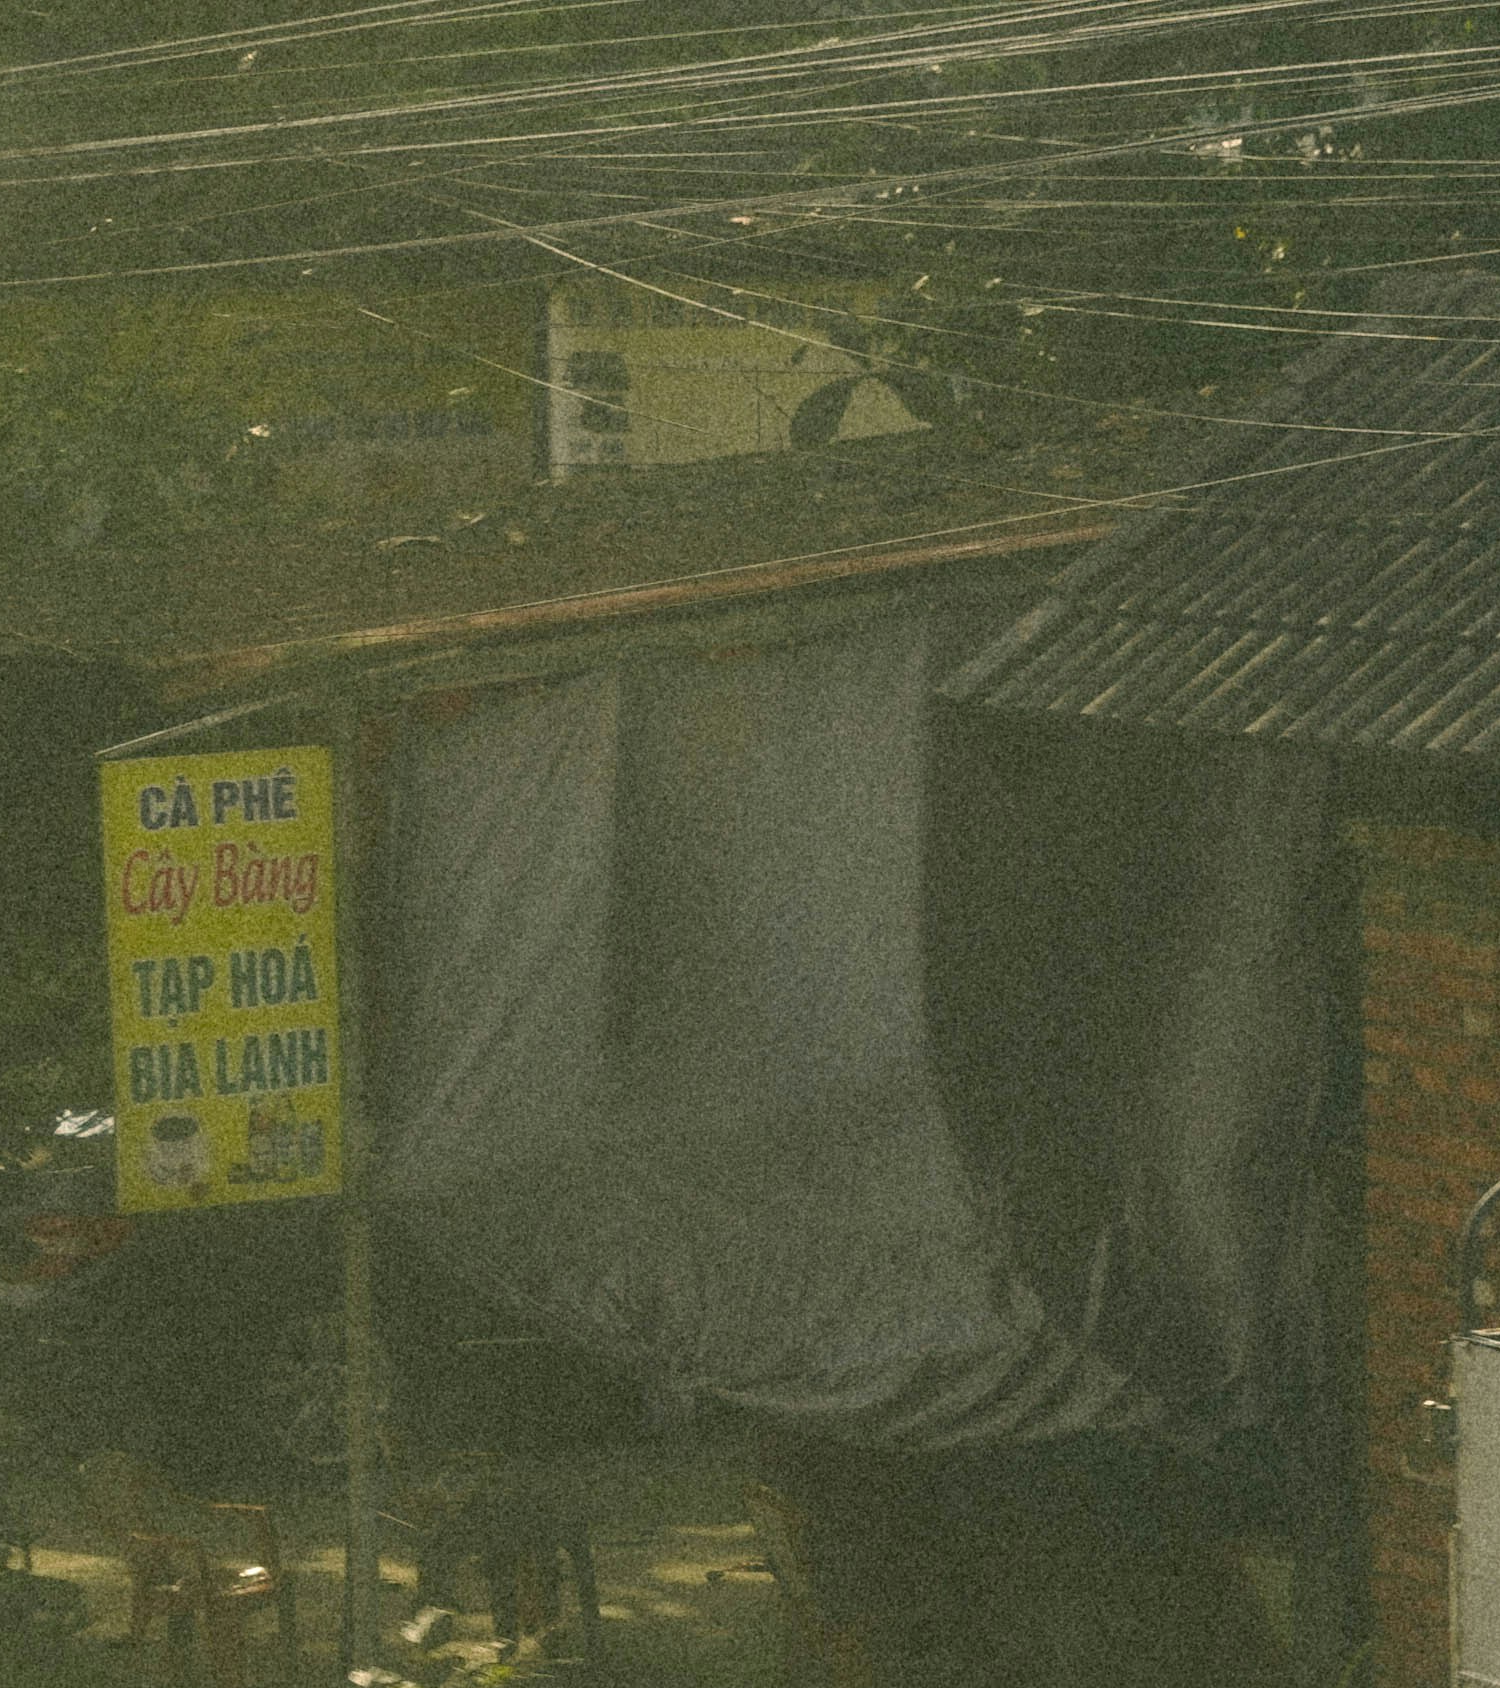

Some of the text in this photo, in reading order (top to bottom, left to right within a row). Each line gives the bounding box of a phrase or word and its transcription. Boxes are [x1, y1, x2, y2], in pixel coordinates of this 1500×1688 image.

[139, 767, 297, 831] CÀ PHÊ
[122, 840, 319, 926] Cây Bàng
[132, 934, 318, 1029] TẠP HOÁ
[129, 1042, 204, 1104] BIA
